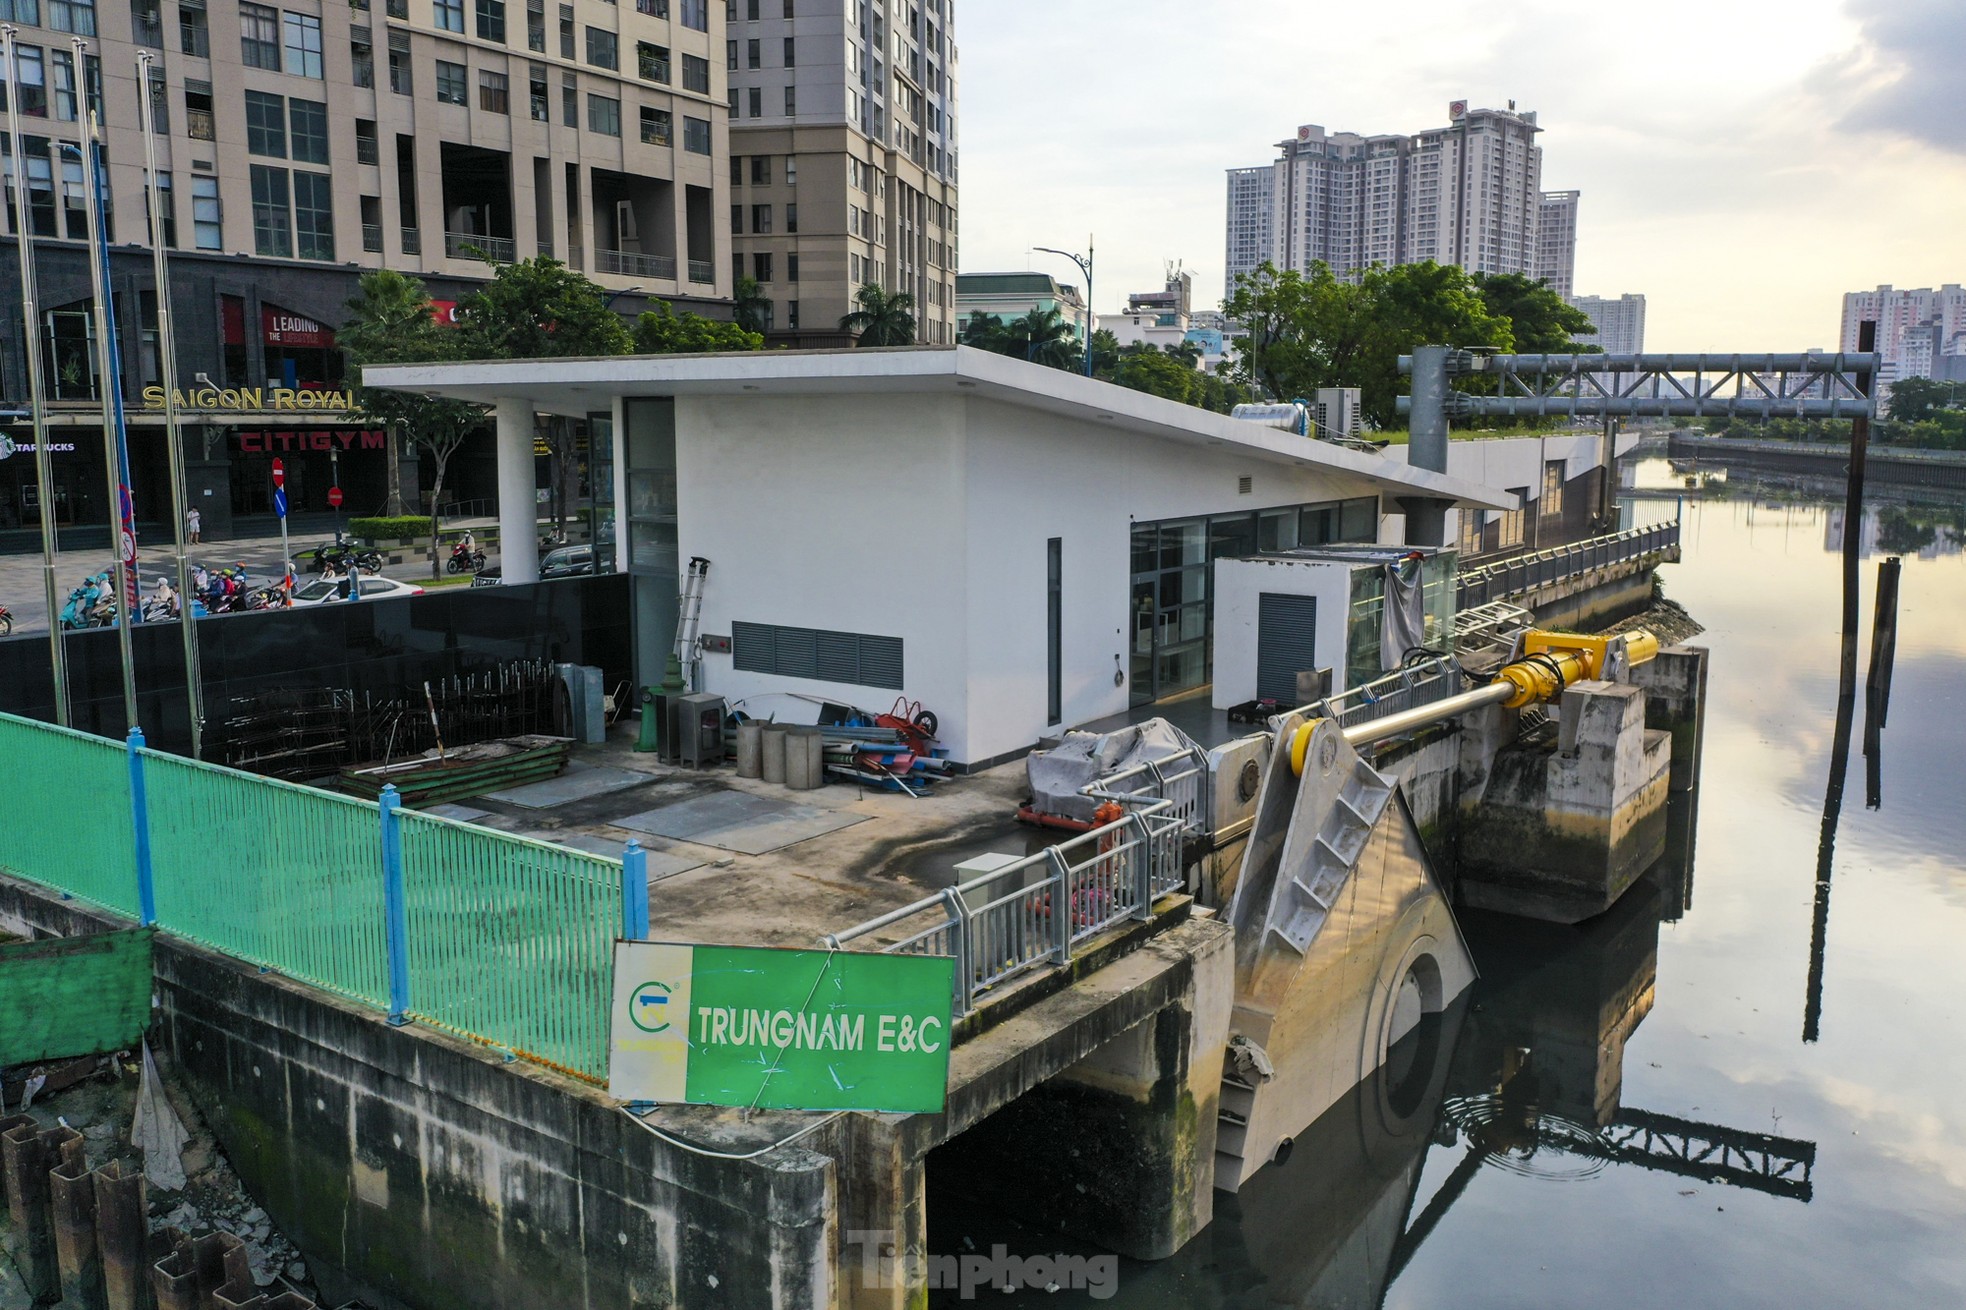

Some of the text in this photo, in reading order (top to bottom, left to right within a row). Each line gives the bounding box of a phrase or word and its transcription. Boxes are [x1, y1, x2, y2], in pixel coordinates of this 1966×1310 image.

[273, 316, 319, 333] LEADING
[269, 332, 281, 341] THE
[142, 386, 363, 411] SAIGON ROYAL
[14, 443, 75, 452] TARUCKS
[239, 431, 385, 453] CITIGYM
[698, 1006, 943, 1054] TRUNGNAM E&C
